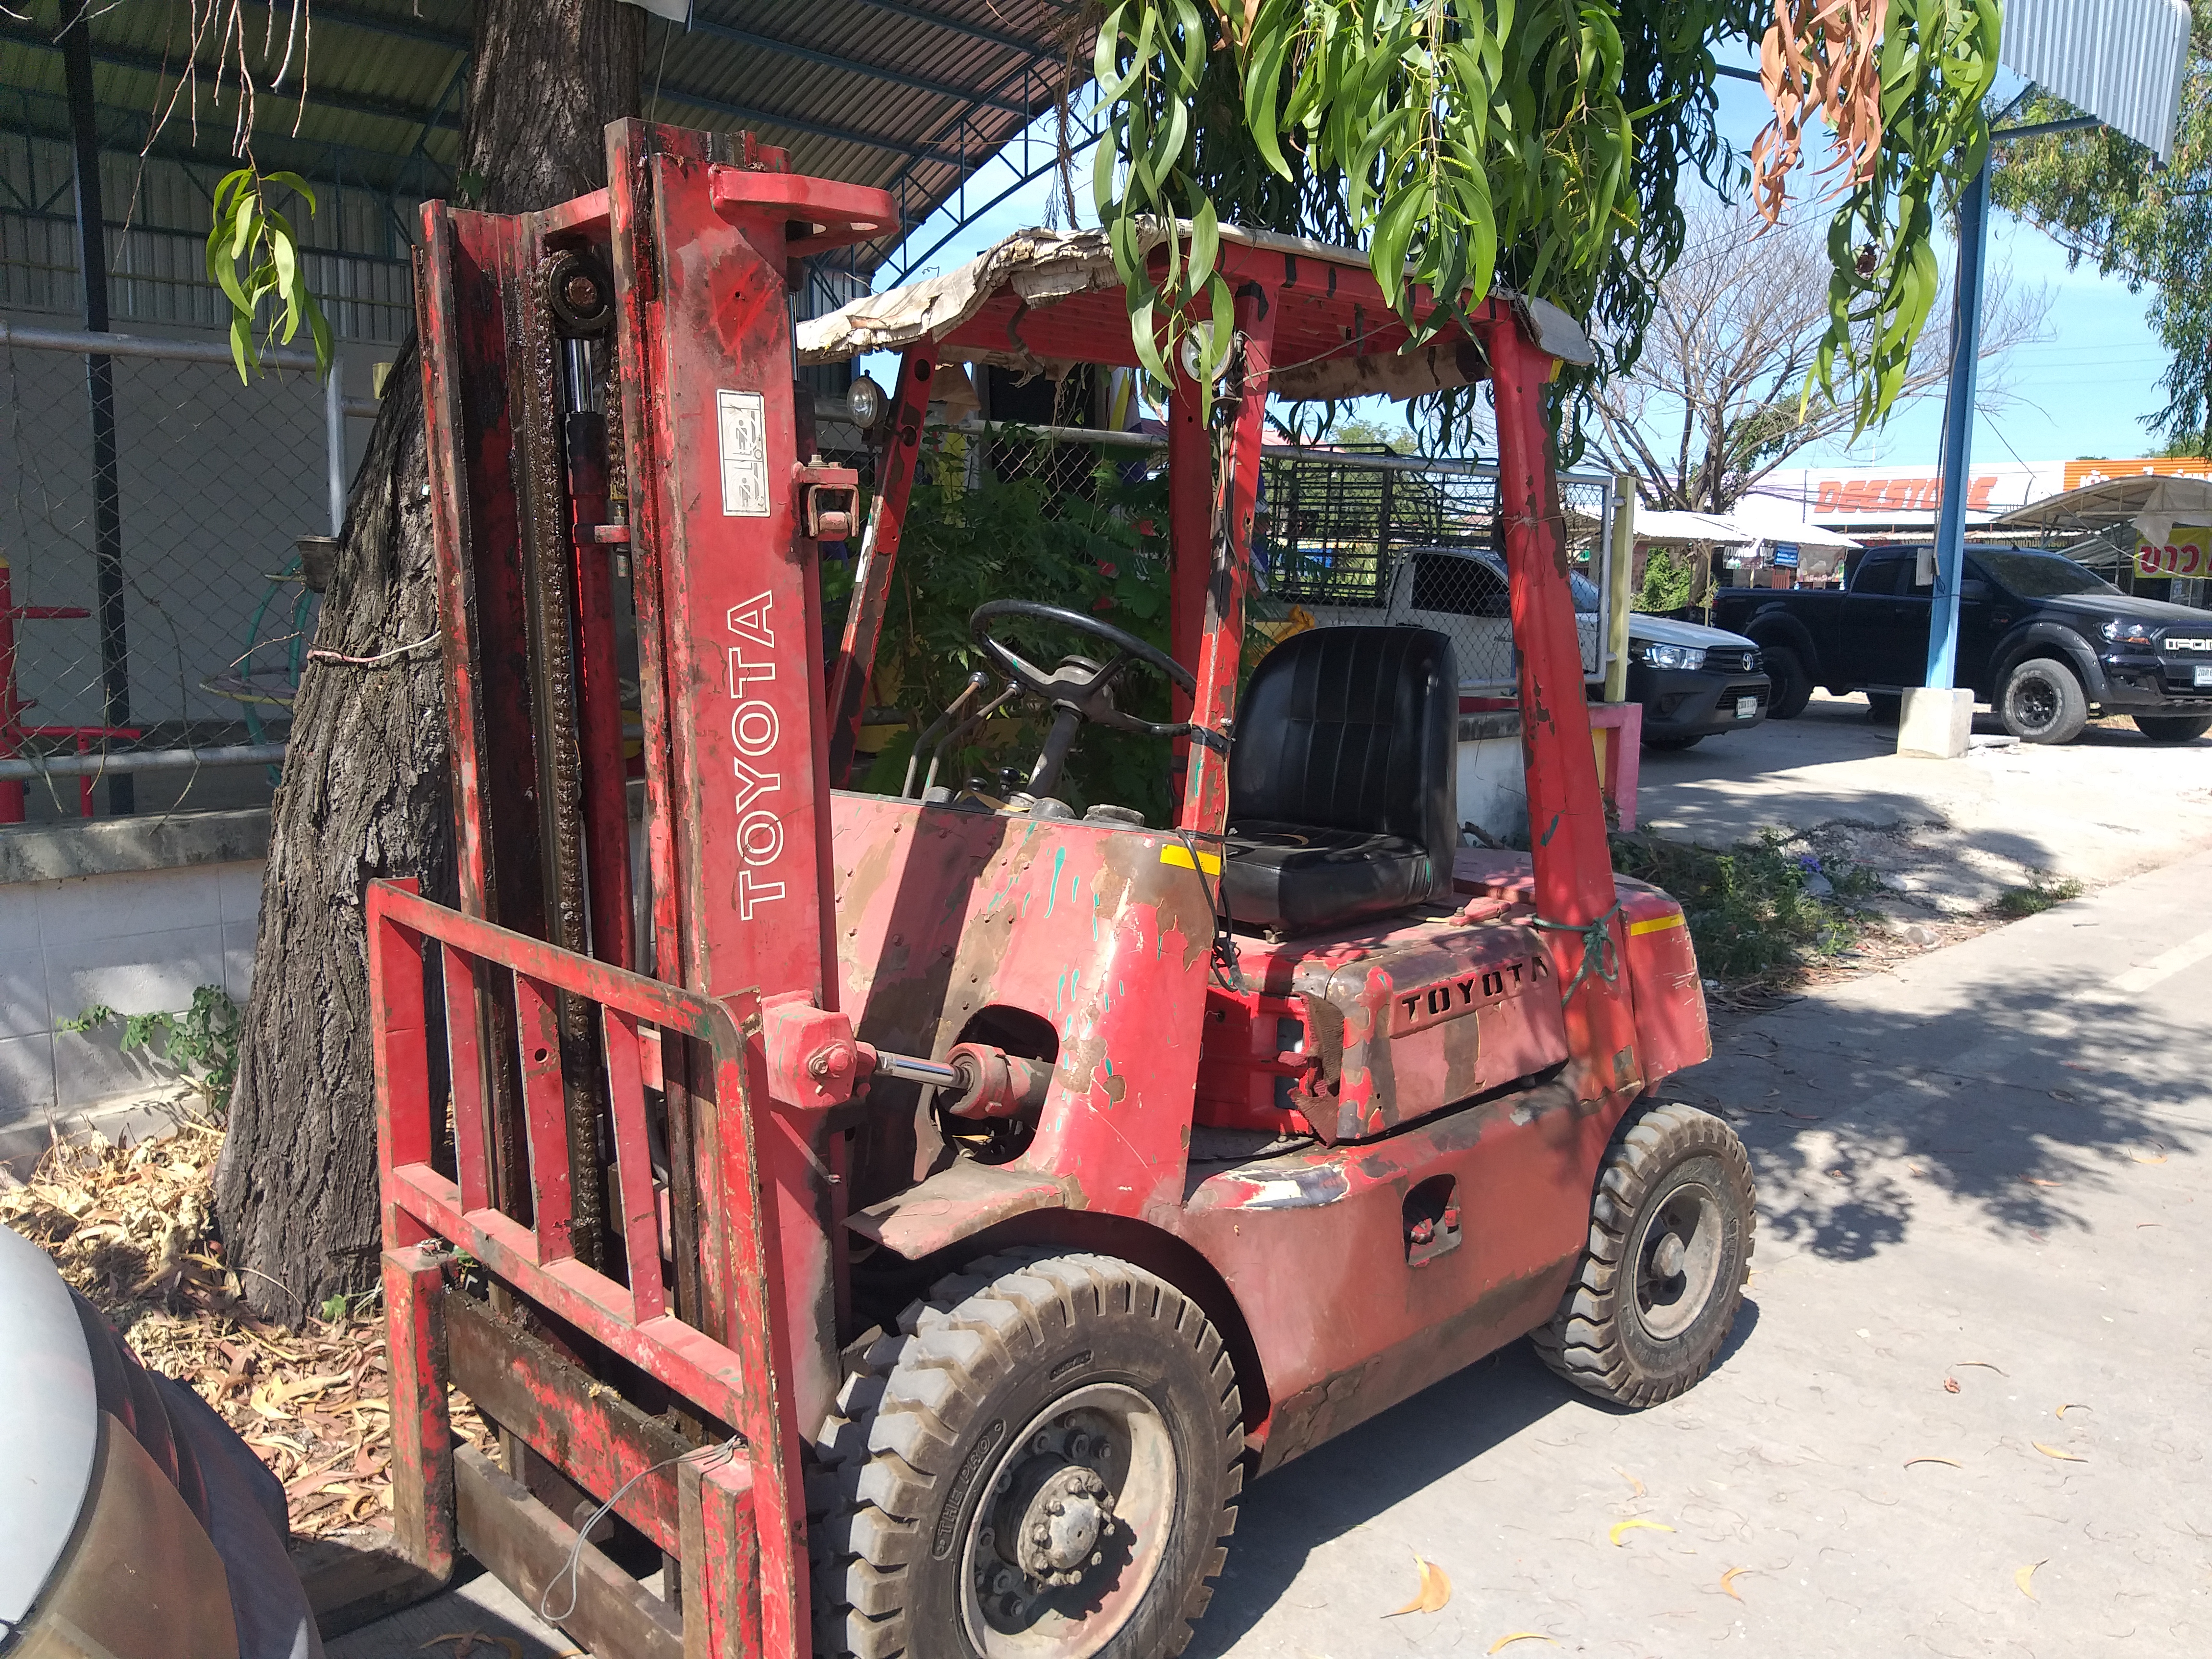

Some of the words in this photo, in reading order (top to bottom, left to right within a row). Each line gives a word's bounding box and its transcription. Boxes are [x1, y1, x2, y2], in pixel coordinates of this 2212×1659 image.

[1814, 477, 1997, 513] DEESTOE
[727, 590, 786, 921] TOYOTA
[1402, 957, 1549, 1023] TOYOTA
[938, 1487, 963, 1537] THE
[960, 1435, 991, 1485] PRO
